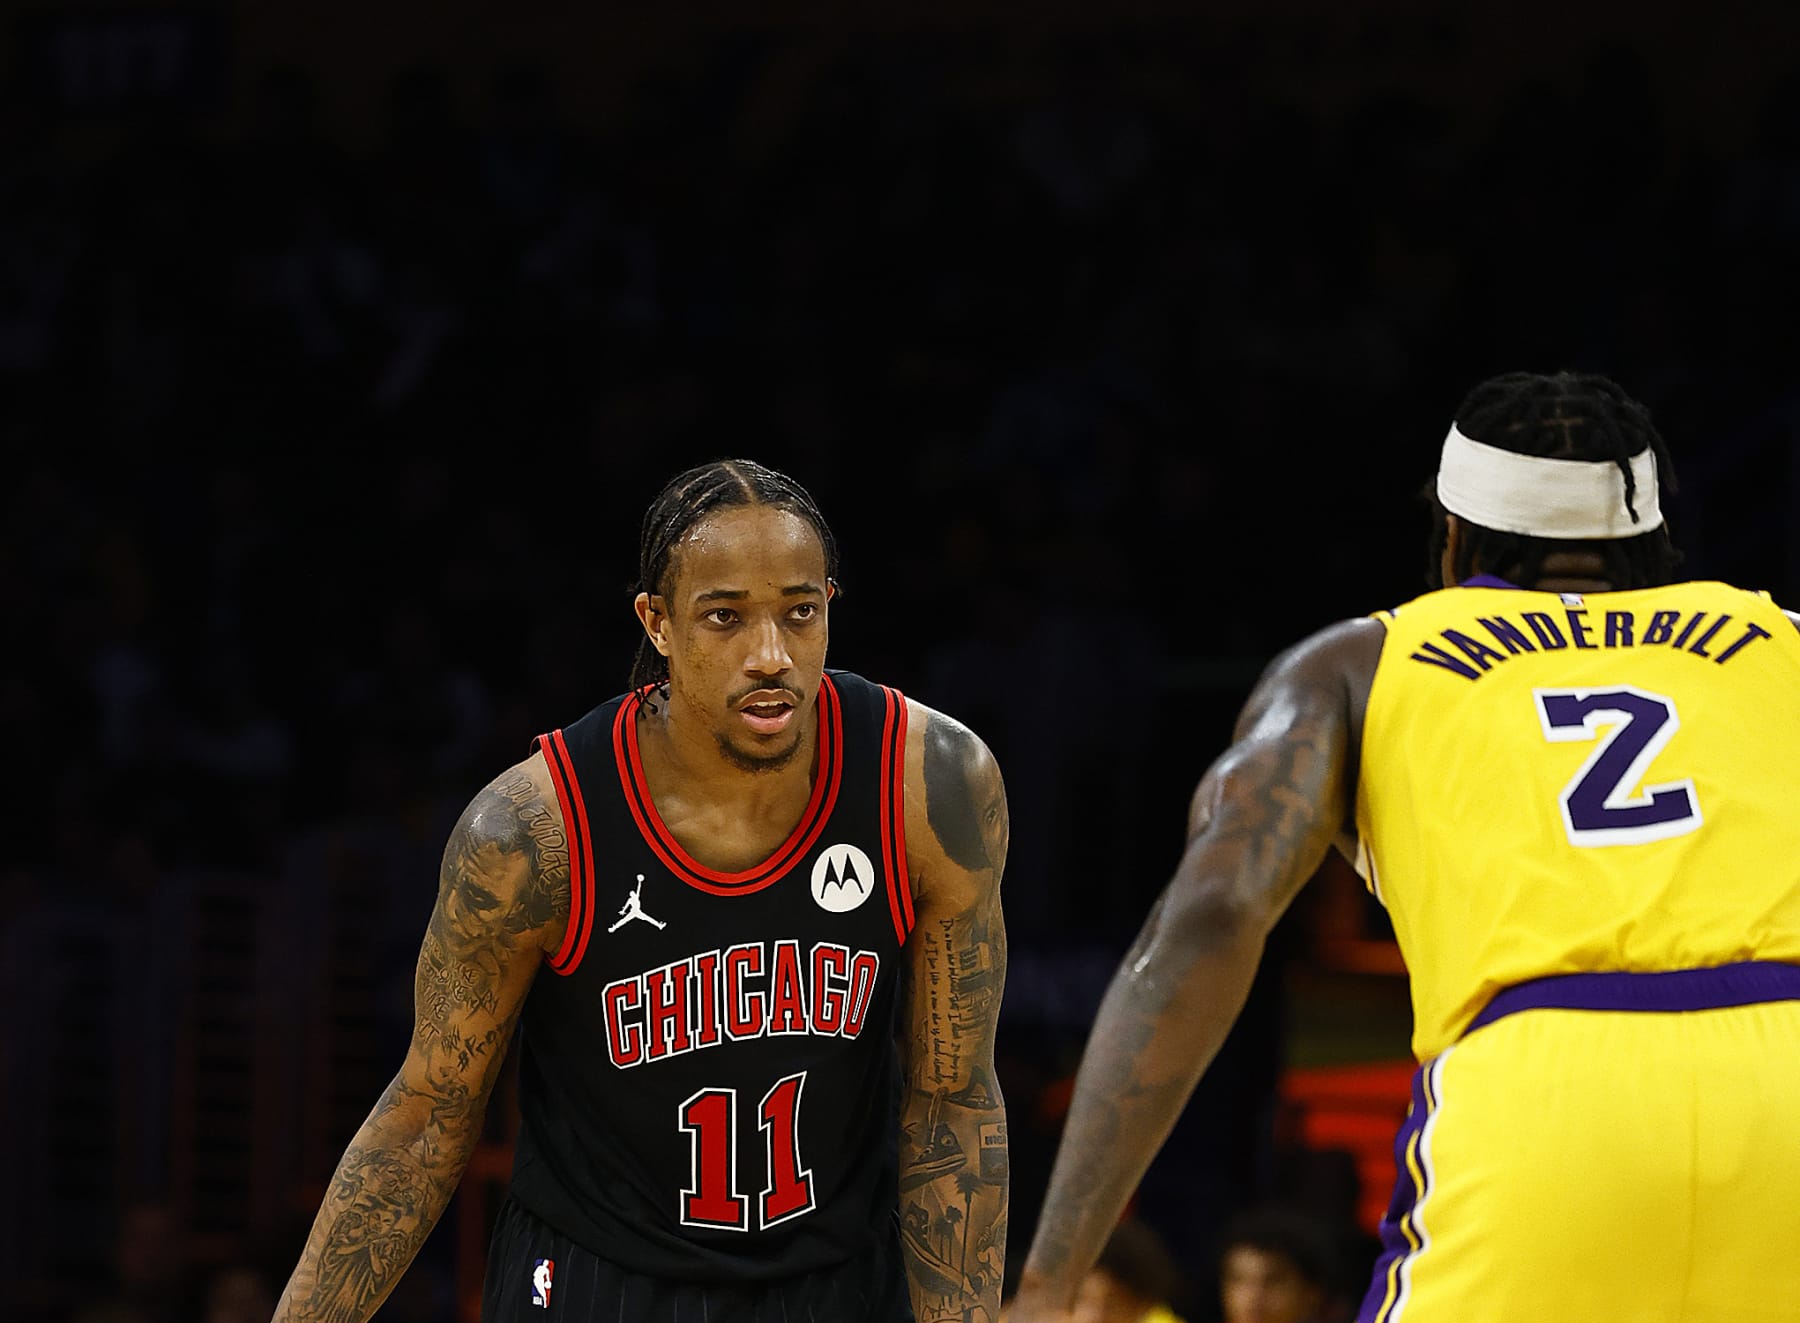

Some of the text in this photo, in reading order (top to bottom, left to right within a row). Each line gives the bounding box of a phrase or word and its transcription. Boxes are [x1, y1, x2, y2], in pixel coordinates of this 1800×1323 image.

[1411, 609, 1772, 681] VANDERBILT
[1532, 684, 1703, 847] 2
[601, 939, 879, 1069] CHICAGO
[678, 1071, 815, 1232] 11
